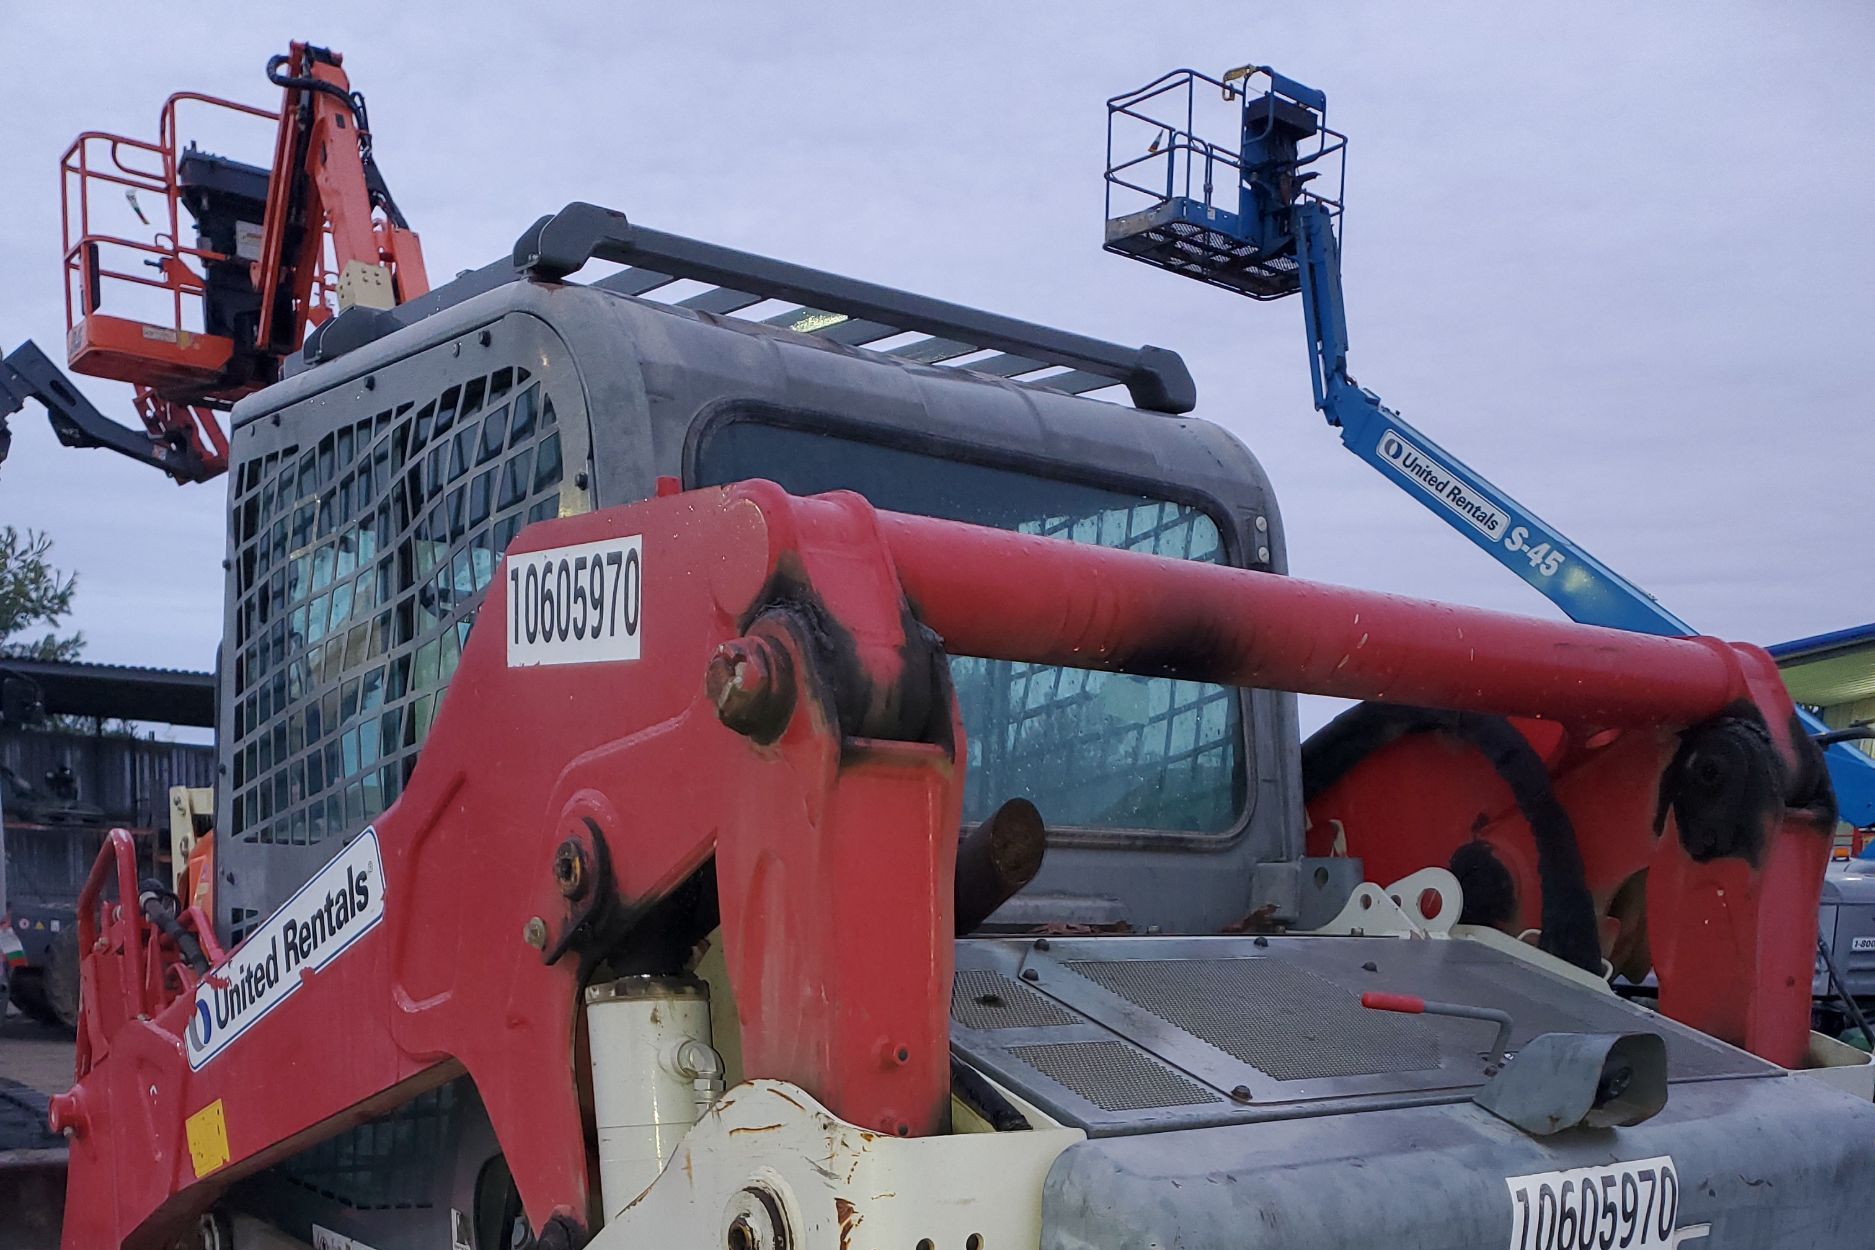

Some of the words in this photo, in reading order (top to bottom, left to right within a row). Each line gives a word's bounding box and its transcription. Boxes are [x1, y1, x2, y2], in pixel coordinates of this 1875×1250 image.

[1402, 451, 1450, 494] United
[1446, 485, 1499, 531] Rentals
[1504, 526, 1566, 576] S-45
[510, 547, 640, 645] 10605970
[214, 935, 280, 1030] United
